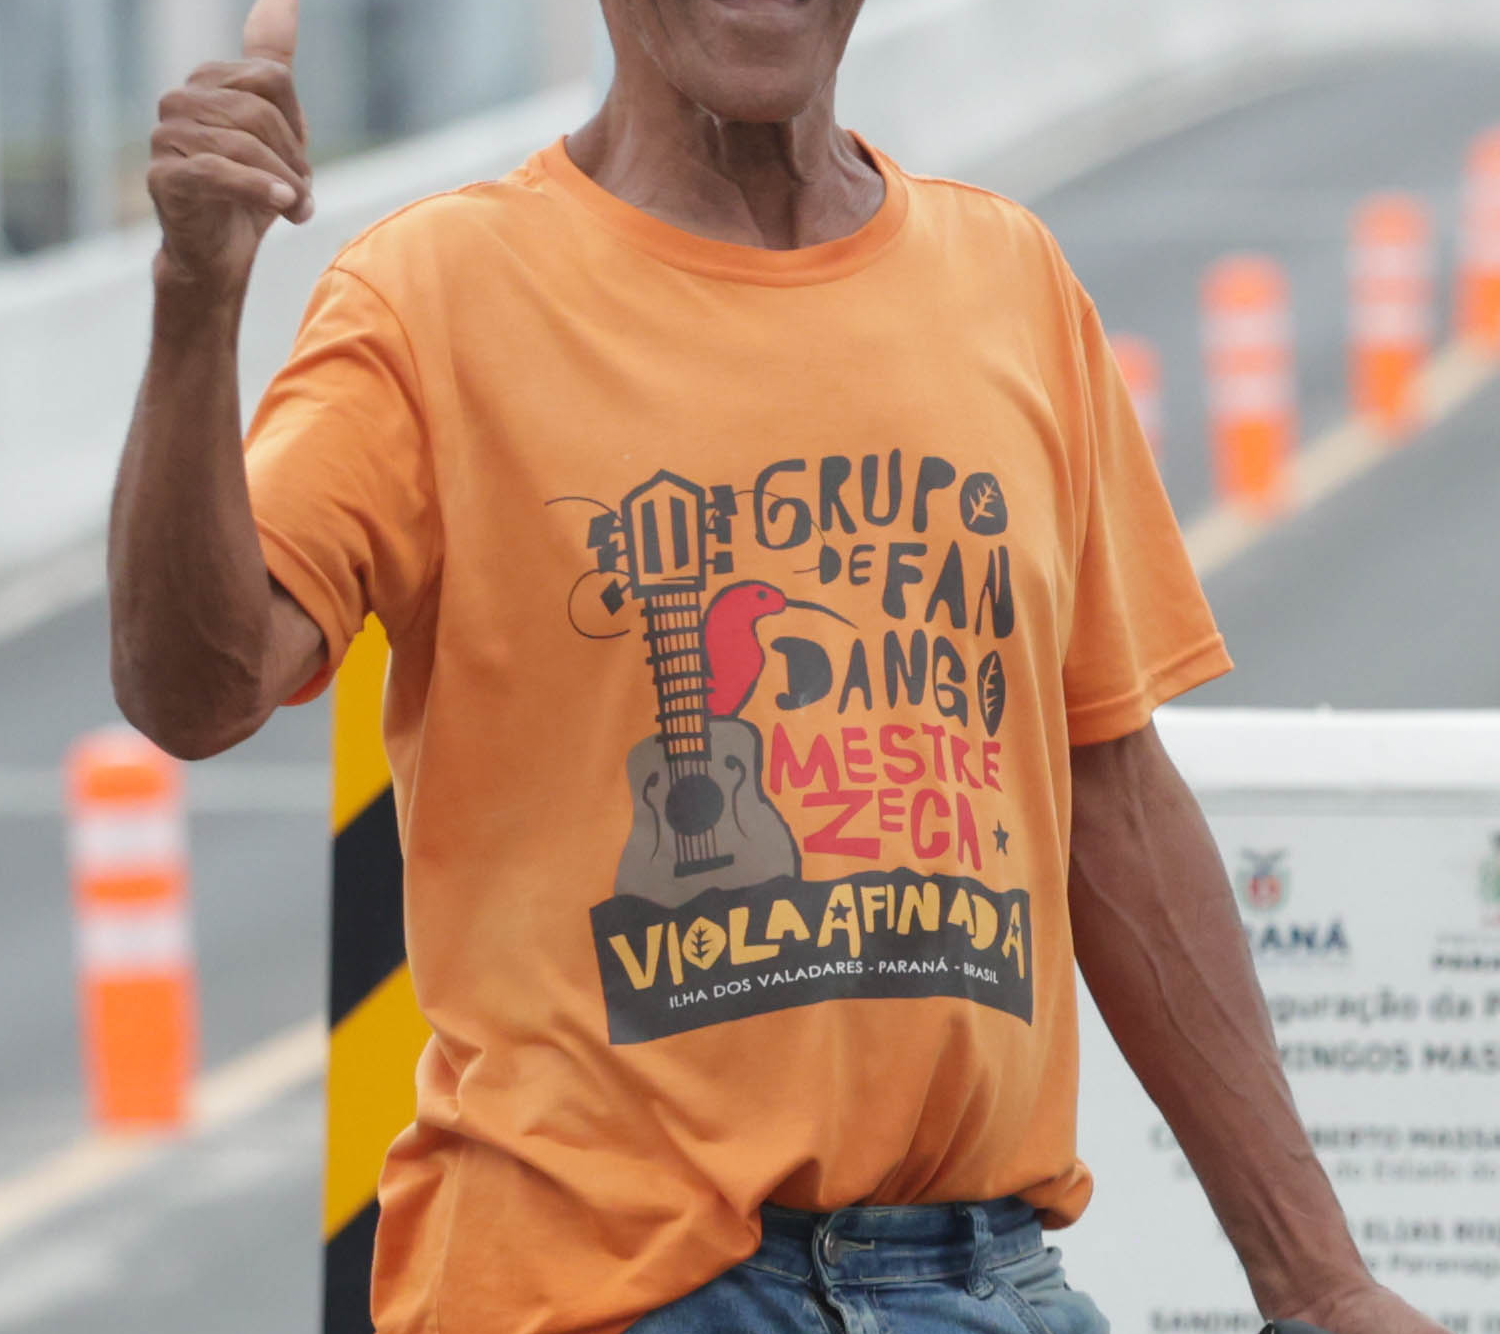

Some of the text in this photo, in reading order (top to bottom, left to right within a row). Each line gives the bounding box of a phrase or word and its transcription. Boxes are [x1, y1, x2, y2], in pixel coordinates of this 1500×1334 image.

[753, 448, 1008, 550] GRUPO
[818, 540, 1015, 639] DE FAN
[770, 630, 1007, 737] DANGO
[768, 722, 1003, 795] MESTRE
[802, 788, 982, 871] ZECA
[608, 882, 1025, 991] VIOLA AFINADA
[669, 988, 708, 1009] ILHA
[713, 978, 752, 999] DOS
[757, 960, 863, 988] VALADARES
[878, 956, 949, 974] PARANÁ
[963, 961, 999, 985] BRASIL
[1429, 989, 1472, 1022] da
[1307, 1125, 1398, 1151] BERTO
[1373, 1157, 1457, 1180] Estado
